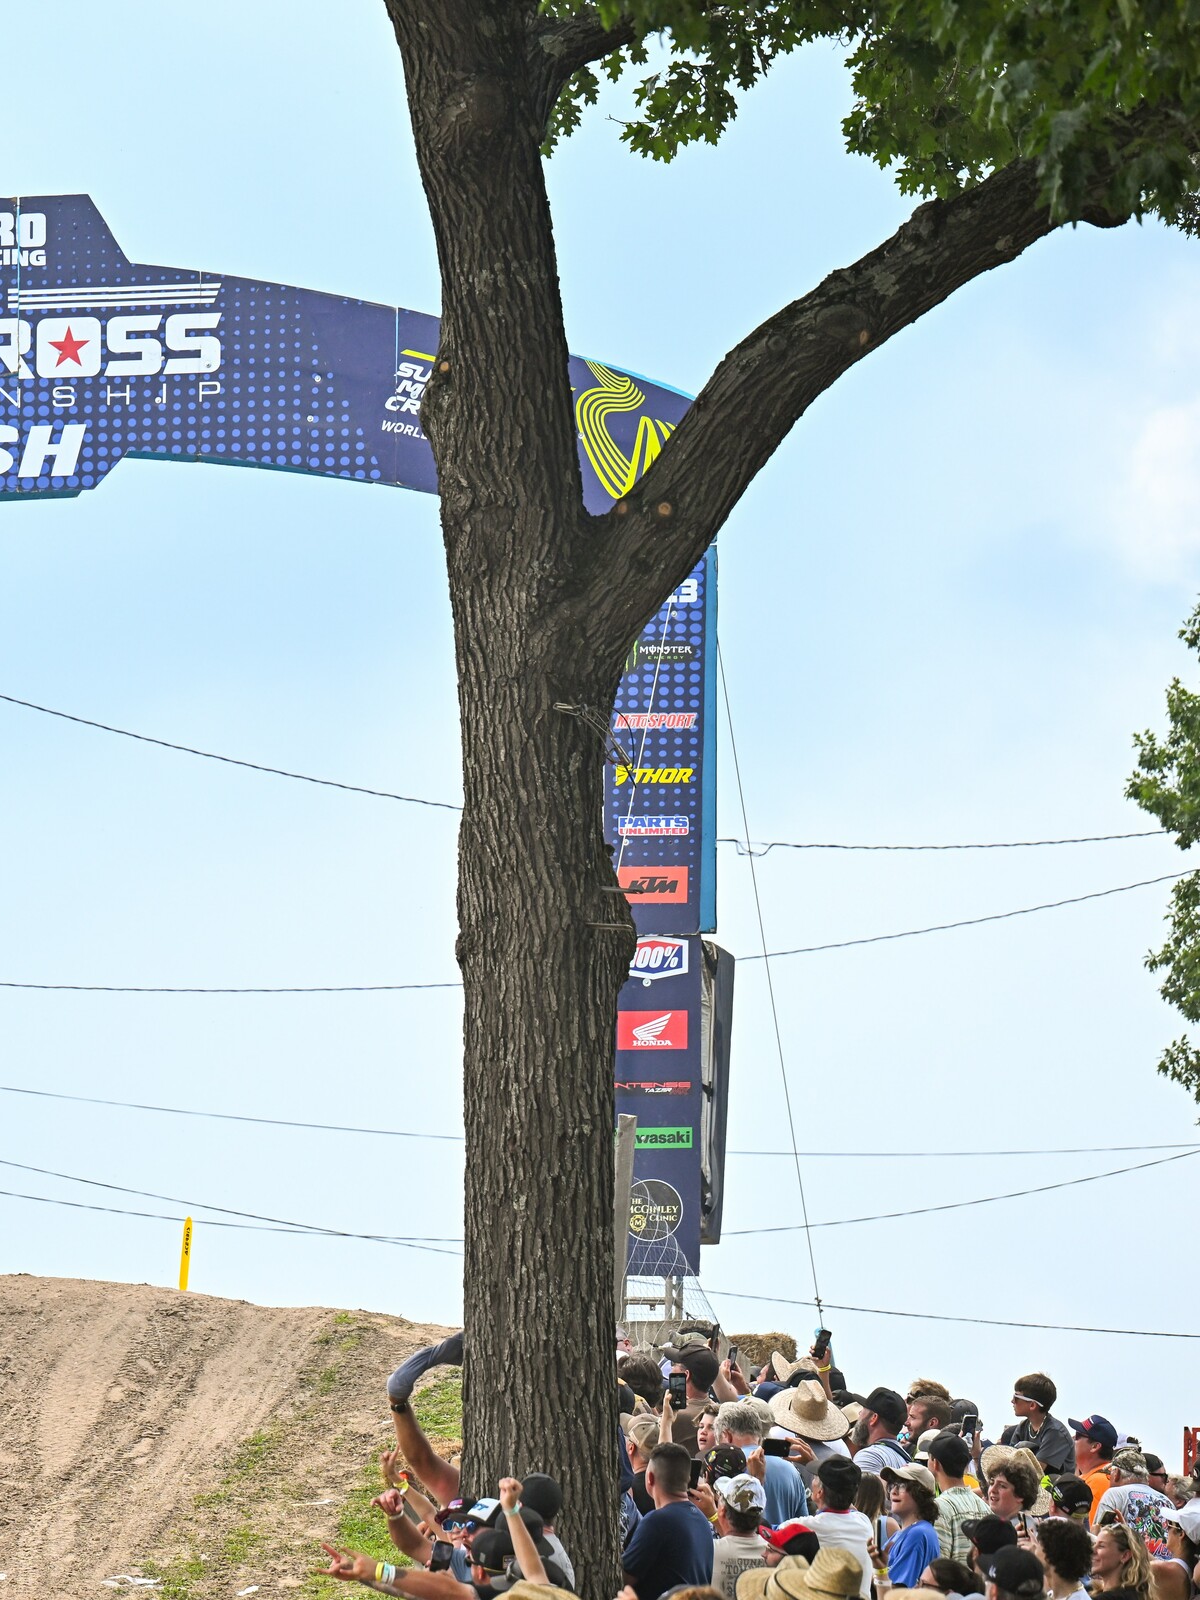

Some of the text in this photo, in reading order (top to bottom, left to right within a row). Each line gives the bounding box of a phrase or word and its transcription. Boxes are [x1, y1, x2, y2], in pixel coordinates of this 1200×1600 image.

[639, 645, 692, 654] MONSTER
[633, 768, 694, 784] THOR
[619, 816, 689, 828] PARTS
[619, 827, 689, 835] UNLIMITED
[628, 876, 679, 894] KTM
[635, 1131, 691, 1144] wasaki
